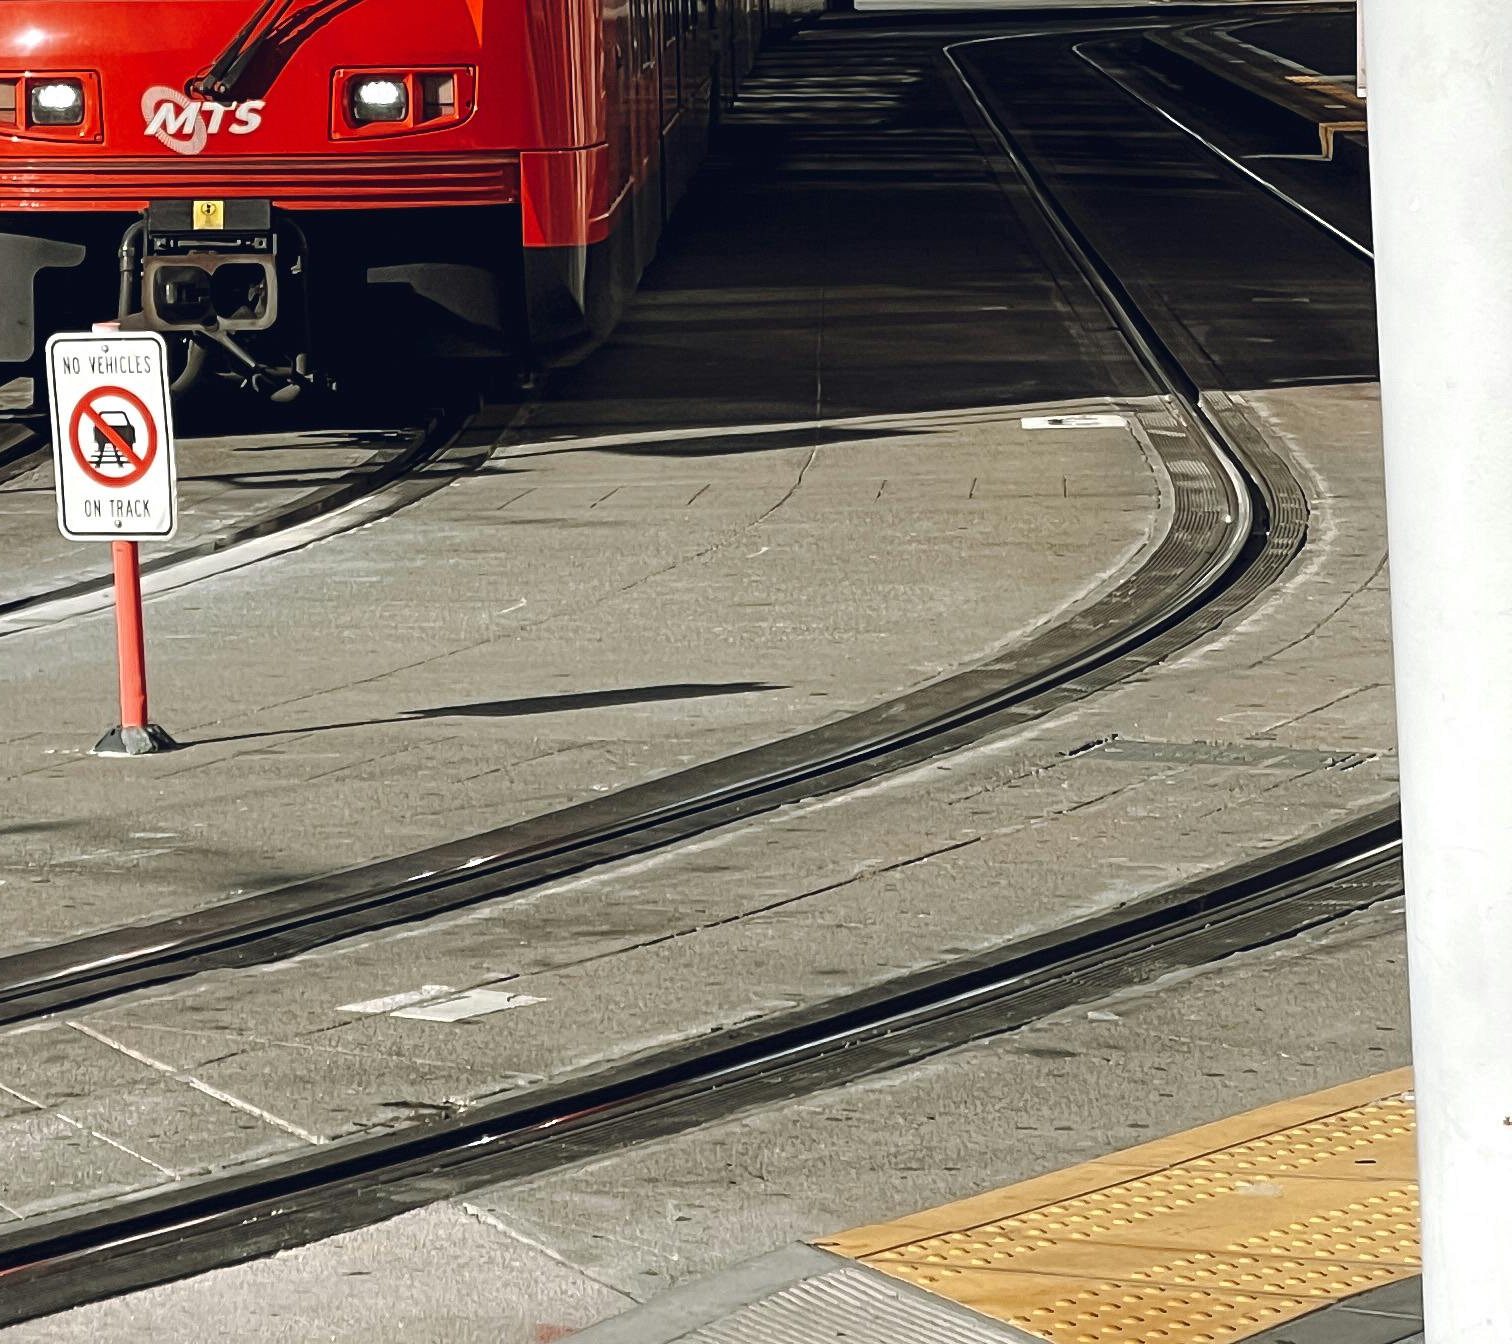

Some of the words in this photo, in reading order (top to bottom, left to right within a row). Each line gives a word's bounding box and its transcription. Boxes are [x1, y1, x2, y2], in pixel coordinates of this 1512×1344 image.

[143, 100, 267, 135] MTS
[63, 356, 81, 375] NO
[88, 355, 151, 375] VEHICLES
[84, 499, 101, 518] ON
[109, 499, 151, 518] TRACK
